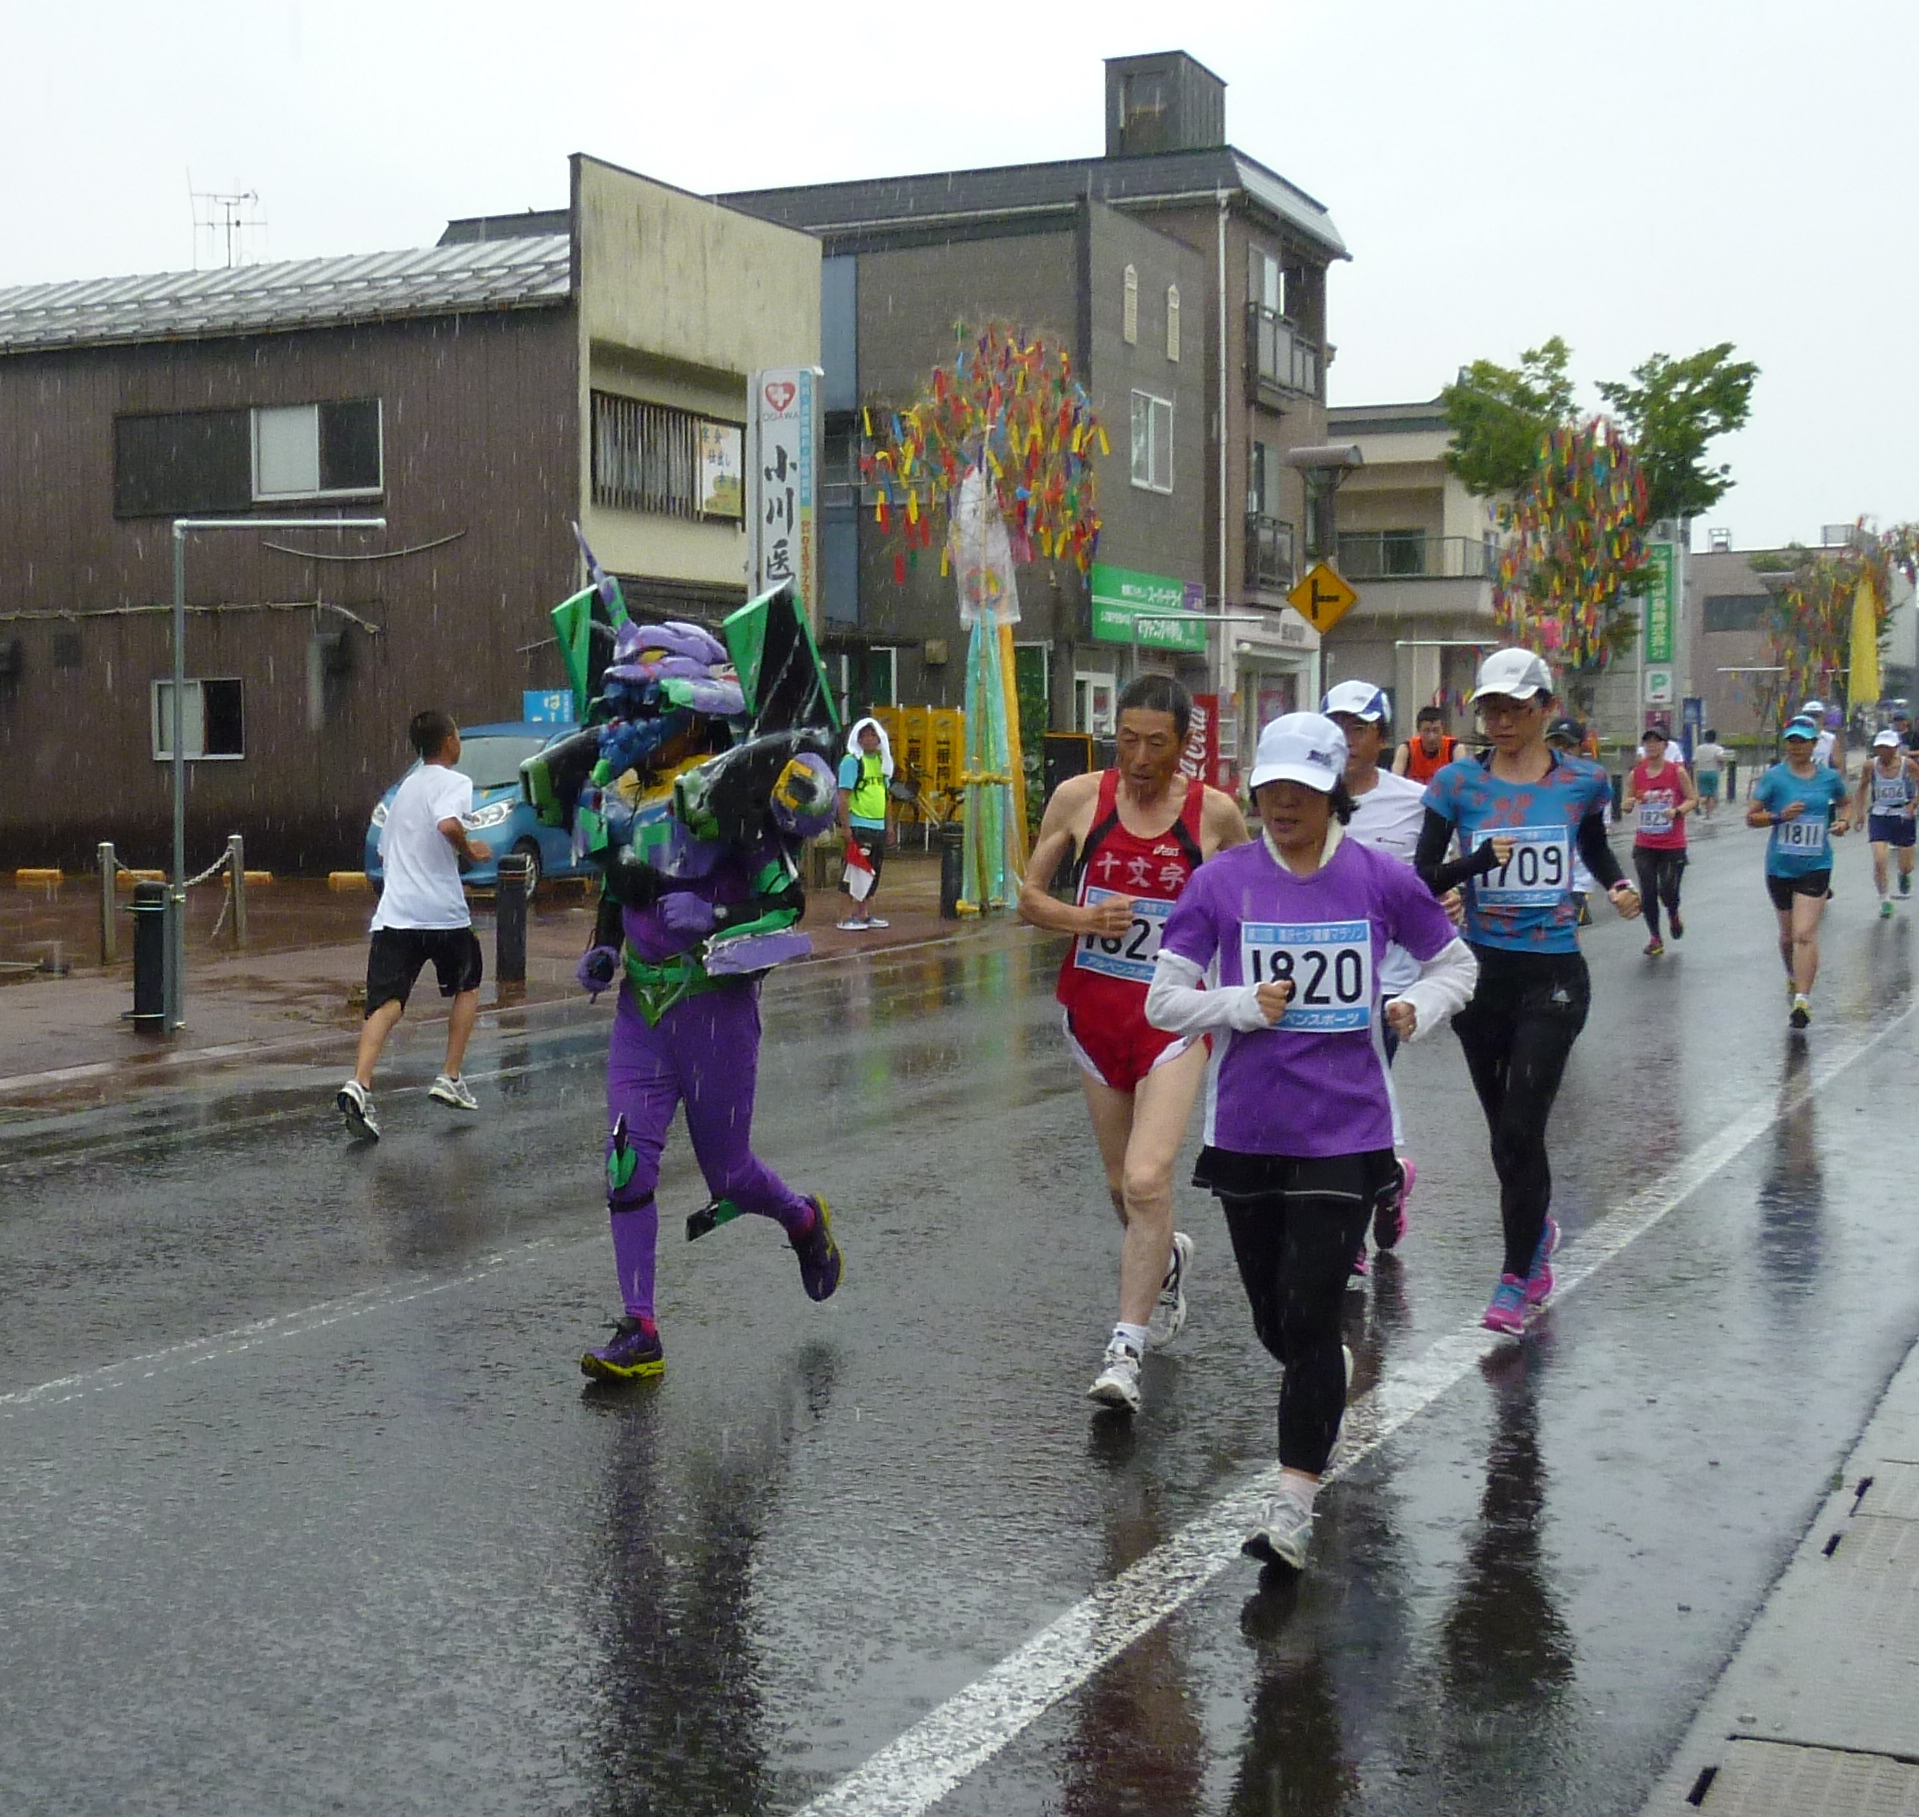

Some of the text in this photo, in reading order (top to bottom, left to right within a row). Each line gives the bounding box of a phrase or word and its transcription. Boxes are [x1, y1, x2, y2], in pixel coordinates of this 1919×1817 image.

[1783, 824, 1818, 845] 1811
[1097, 851, 1187, 892] 十文字
[1084, 955, 1154, 977] アルペンスポー
[1252, 948, 1362, 1005] 1820
